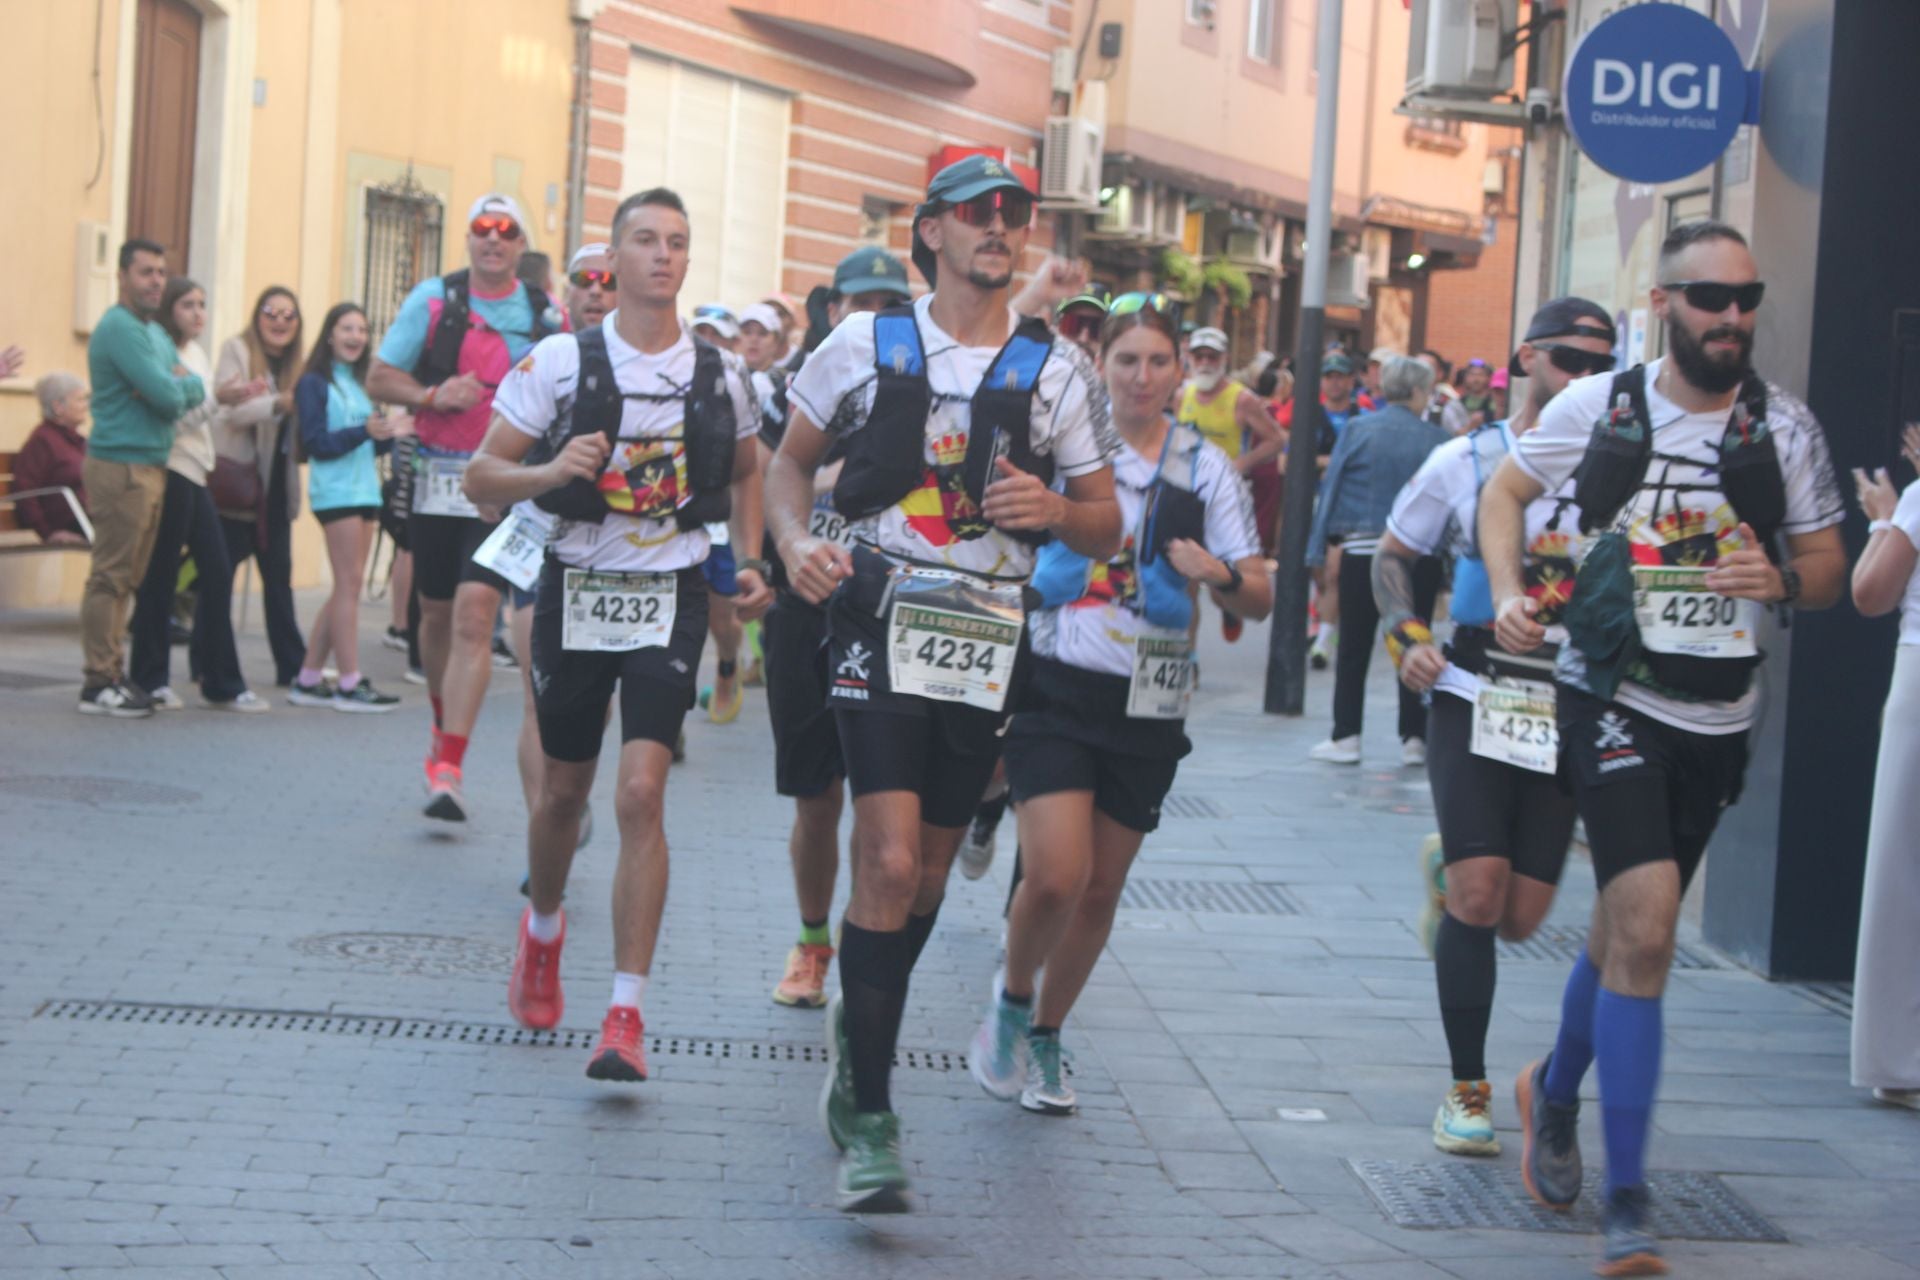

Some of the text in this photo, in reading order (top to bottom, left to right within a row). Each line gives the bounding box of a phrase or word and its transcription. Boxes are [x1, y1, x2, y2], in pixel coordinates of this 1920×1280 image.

[1592, 59, 1721, 110] DIGI
[1591, 111, 1717, 130] Distribuidor oficial
[501, 533, 536, 563] 981
[591, 595, 660, 623] 4232
[1661, 596, 1736, 627] 4230
[916, 635, 996, 676] 4234
